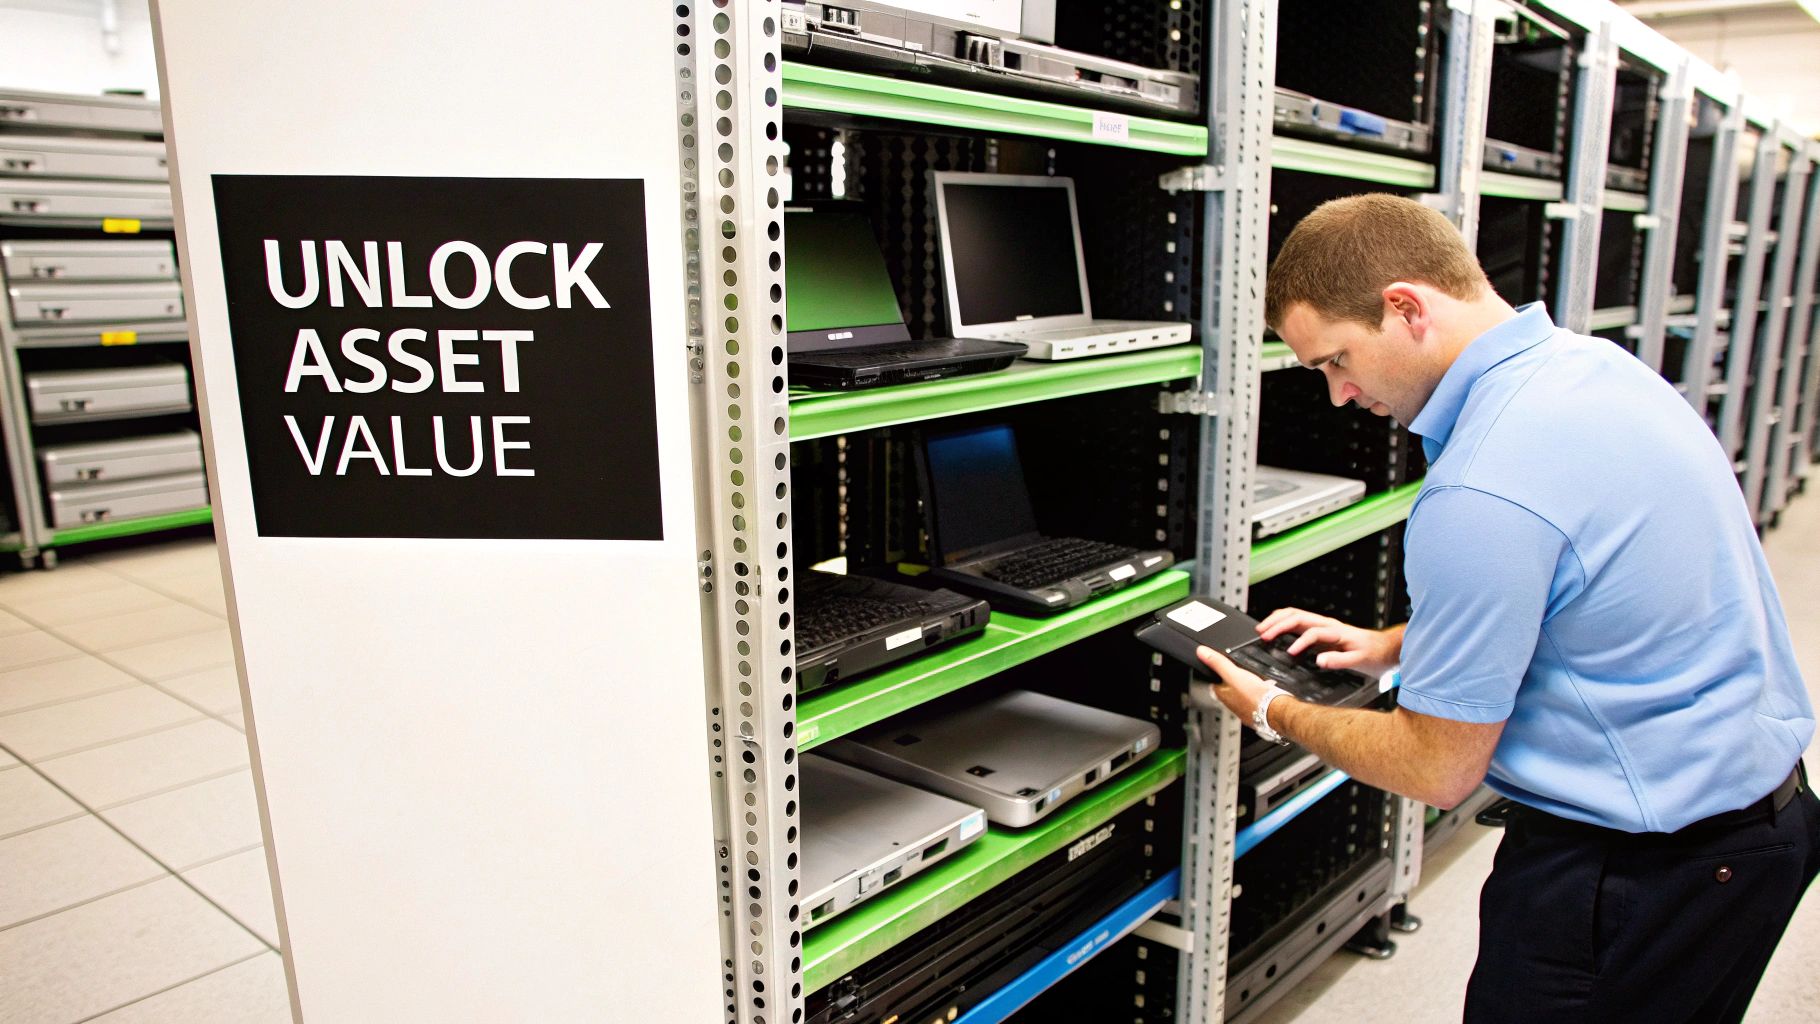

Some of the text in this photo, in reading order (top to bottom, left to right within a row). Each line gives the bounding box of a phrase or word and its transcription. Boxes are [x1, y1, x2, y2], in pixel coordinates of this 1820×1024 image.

[264, 240, 611, 309] UNLOCK
[285, 328, 534, 393] ASSET
[284, 415, 535, 477] VALUE
